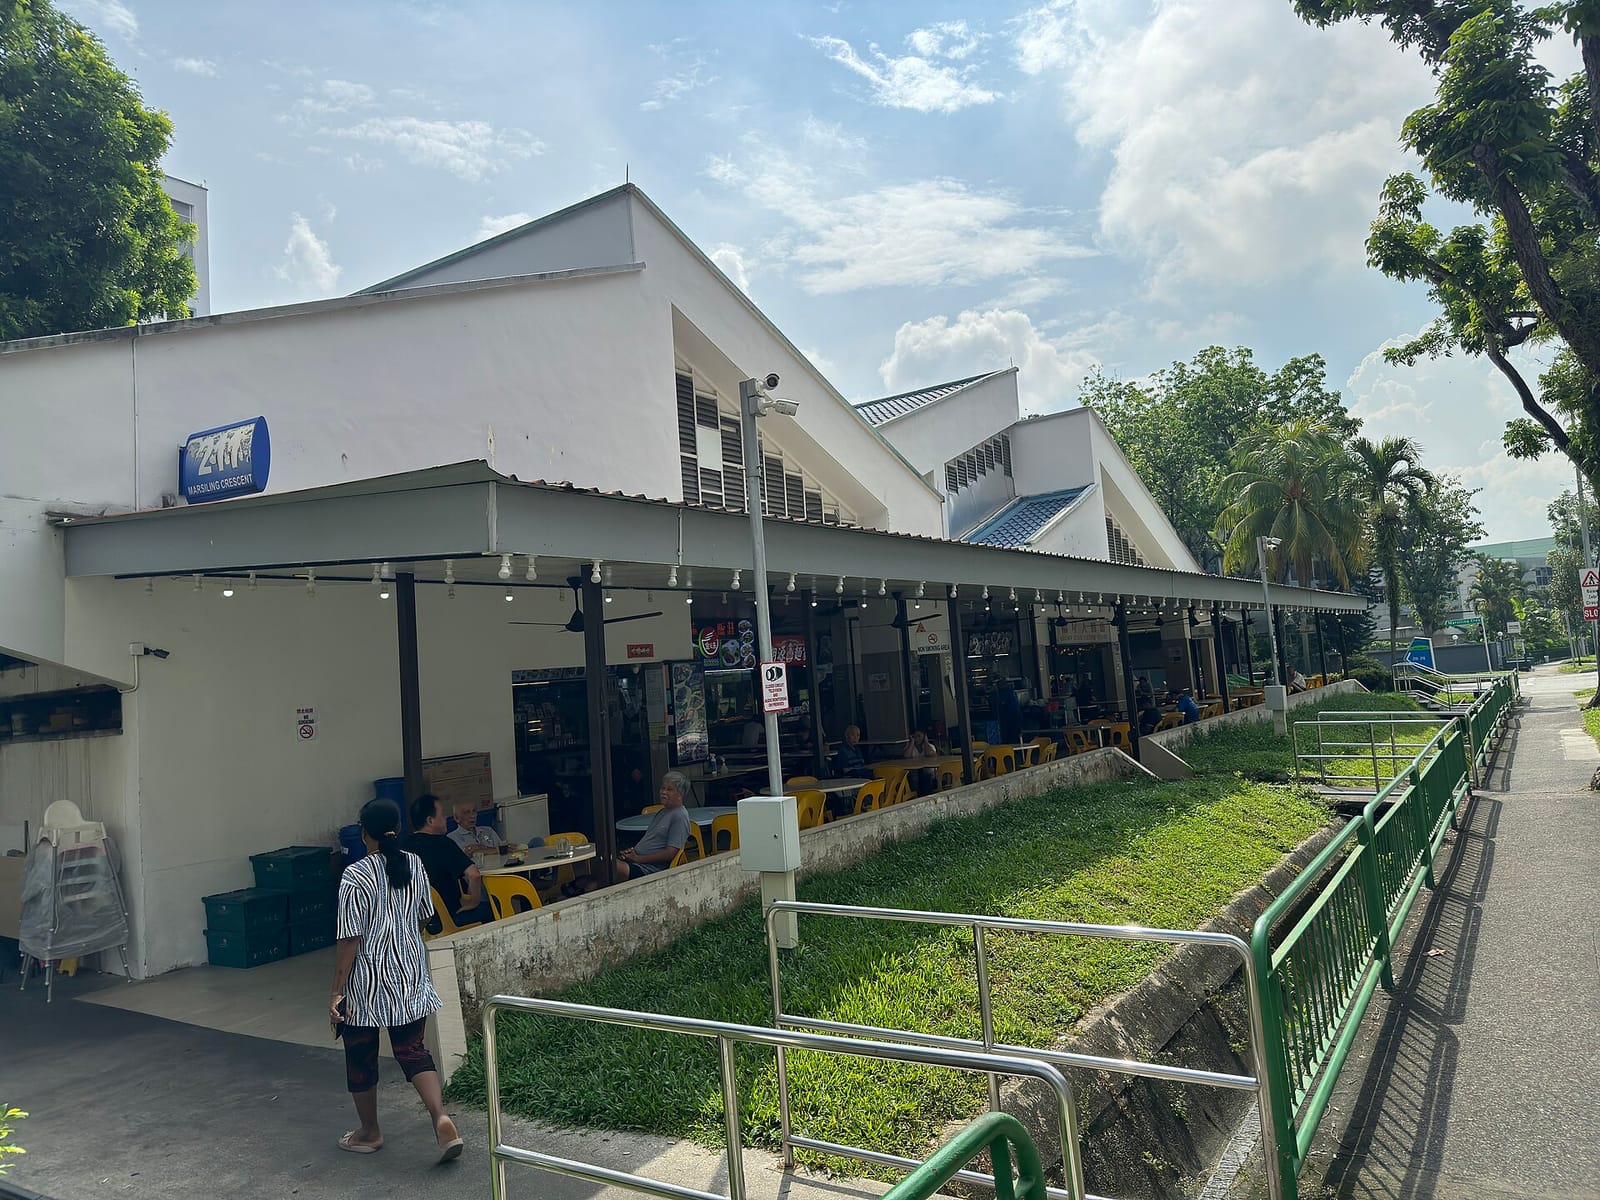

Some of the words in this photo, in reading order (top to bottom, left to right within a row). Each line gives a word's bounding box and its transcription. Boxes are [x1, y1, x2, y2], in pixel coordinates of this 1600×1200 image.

[198, 431, 241, 476] 211
[188, 482, 222, 495] MARSILING
[221, 475, 253, 489] CRESCENT
[1584, 609, 1598, 617] SLO
